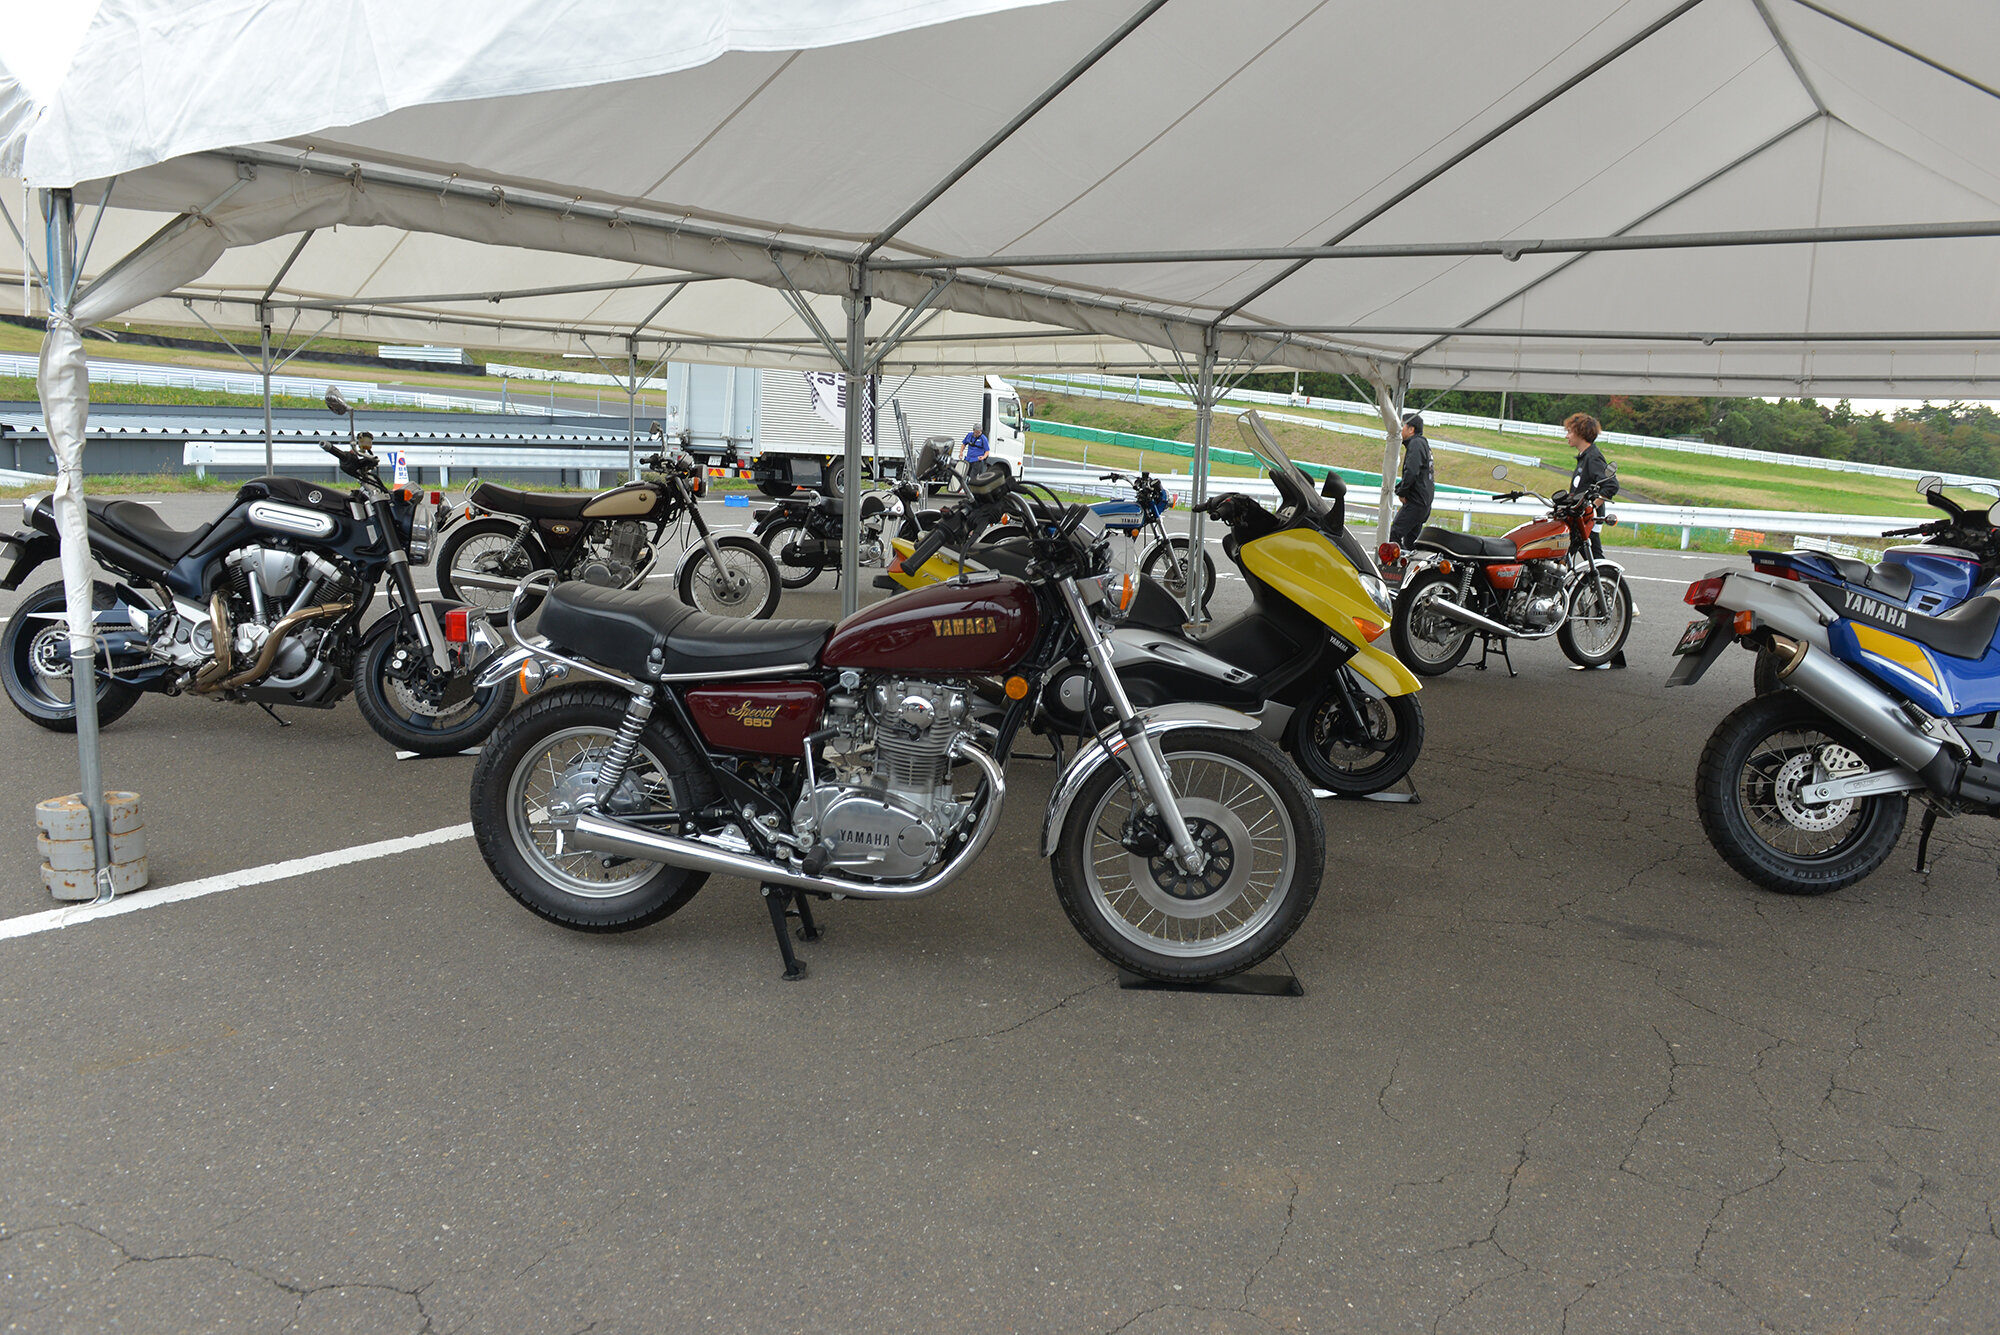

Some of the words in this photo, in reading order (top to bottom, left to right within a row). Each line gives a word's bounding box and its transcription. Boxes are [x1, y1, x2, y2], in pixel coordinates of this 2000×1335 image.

[1844, 591, 1907, 629] YAMAHA
[932, 616, 997, 637] YAMAHA
[1329, 635, 1348, 653] YAMAHA
[726, 700, 781, 721] Special
[743, 717, 773, 728] 650
[840, 829, 890, 847] YAMAHA
